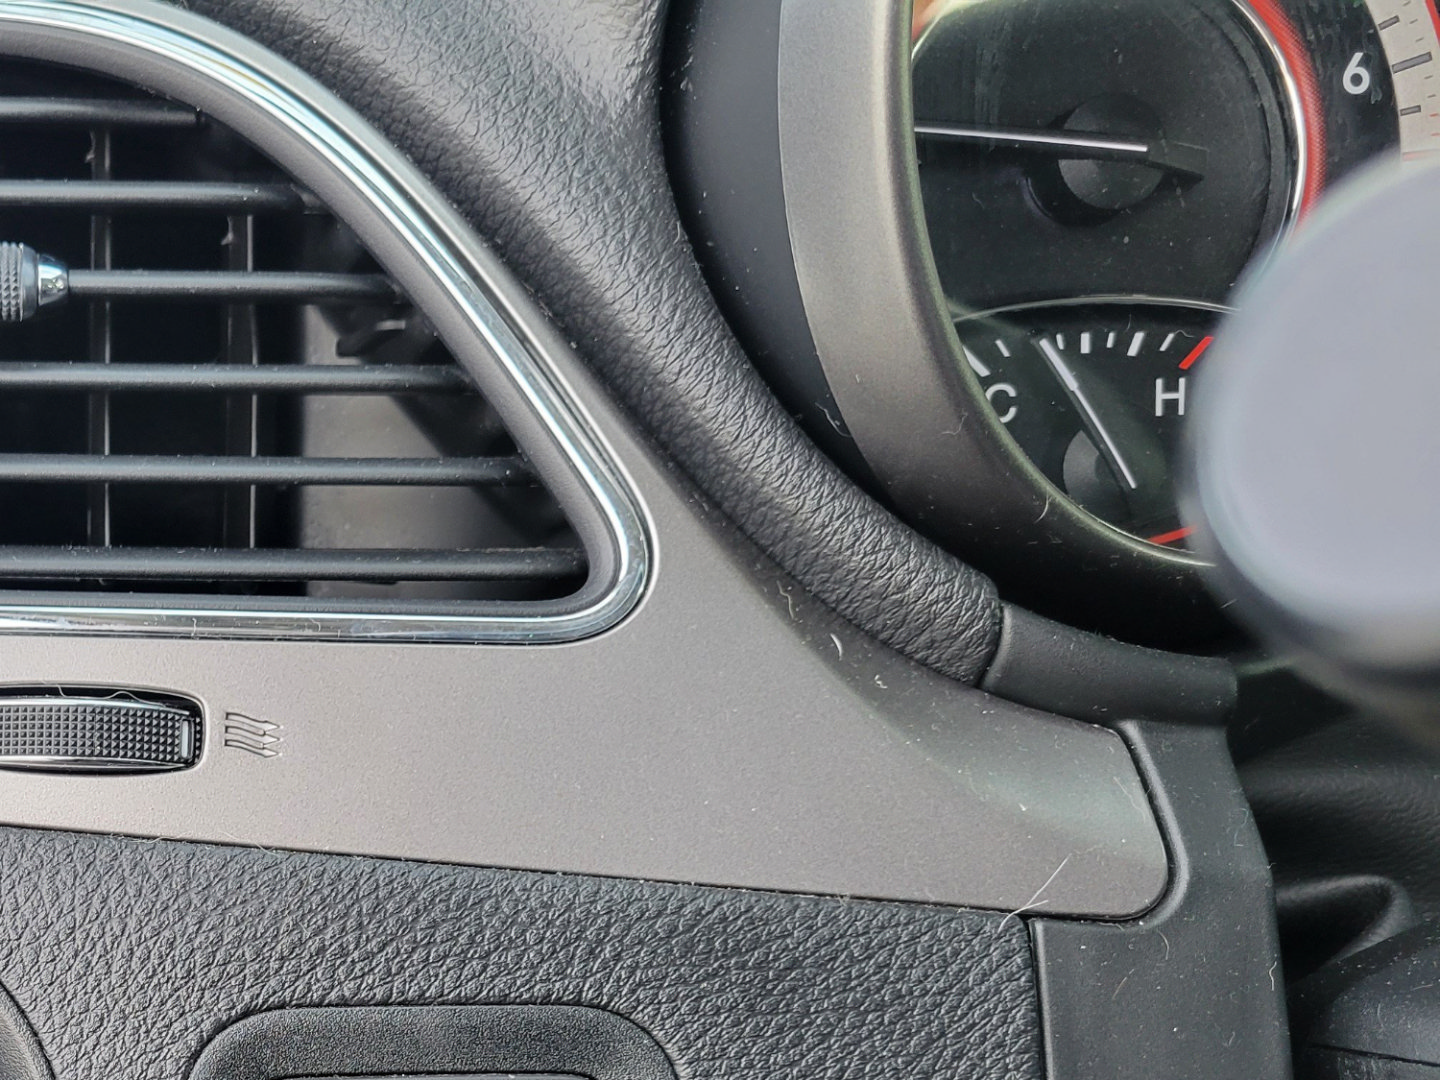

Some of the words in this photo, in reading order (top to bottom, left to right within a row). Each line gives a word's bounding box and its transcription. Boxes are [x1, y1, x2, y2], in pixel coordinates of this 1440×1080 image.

[1342, 51, 1371, 95] 6
[985, 382, 1018, 424] C
[1154, 376, 1186, 417] H
